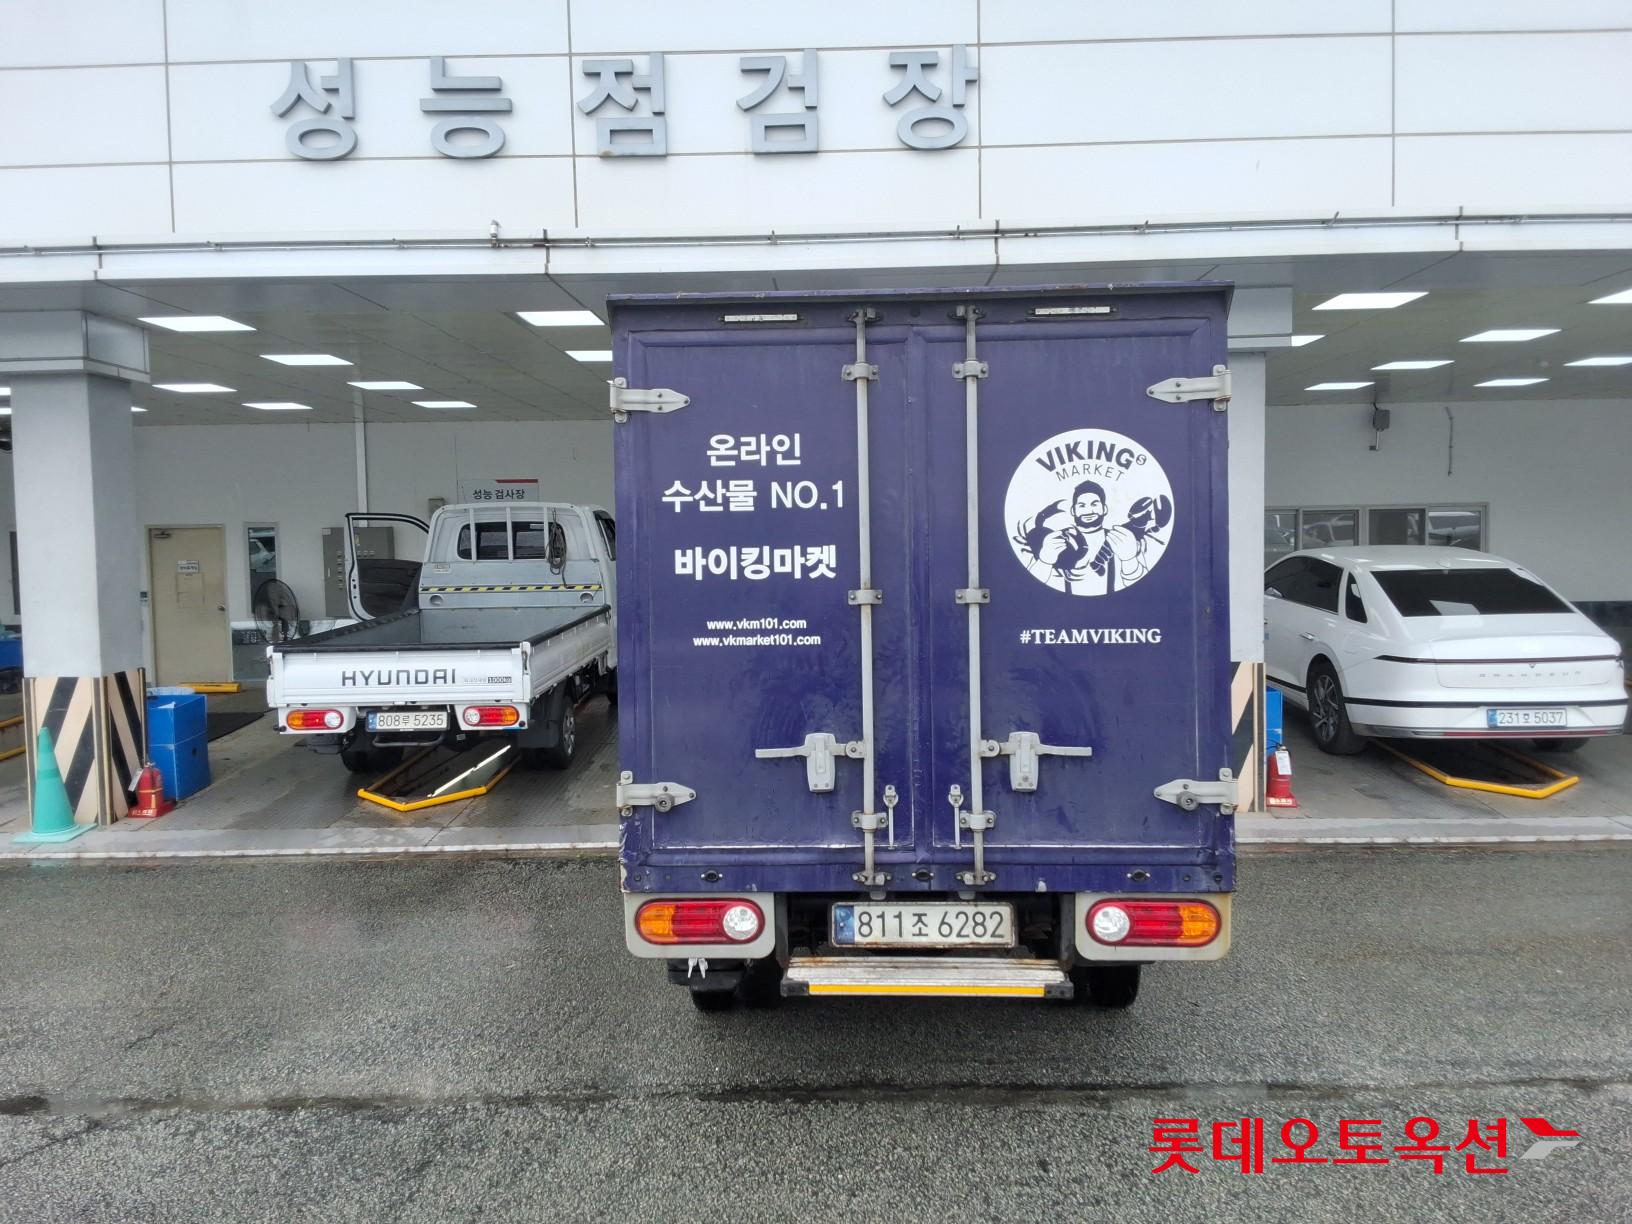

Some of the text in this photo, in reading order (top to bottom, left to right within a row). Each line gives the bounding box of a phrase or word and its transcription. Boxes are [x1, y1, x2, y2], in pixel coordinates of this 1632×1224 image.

[271, 44, 979, 161] 성능점검장
[706, 433, 801, 466] 온라인
[1035, 440, 1136, 472] VIKING
[1055, 463, 1125, 482] MARKET
[472, 488, 526, 500] 성능 검사장
[662, 480, 844, 513] 수산물 NO.1
[674, 545, 837, 581] 바이킹마켓
[706, 617, 807, 631] www.vkm101.com
[692, 634, 821, 647] www.vkmarket101.com
[1019, 628, 1162, 645] #TEAMVIKING
[341, 668, 456, 687] HYUNDAI
[378, 714, 444, 727] 808루 5235
[1533, 711, 1564, 724] 5037
[857, 910, 1005, 939] 811조 6282
